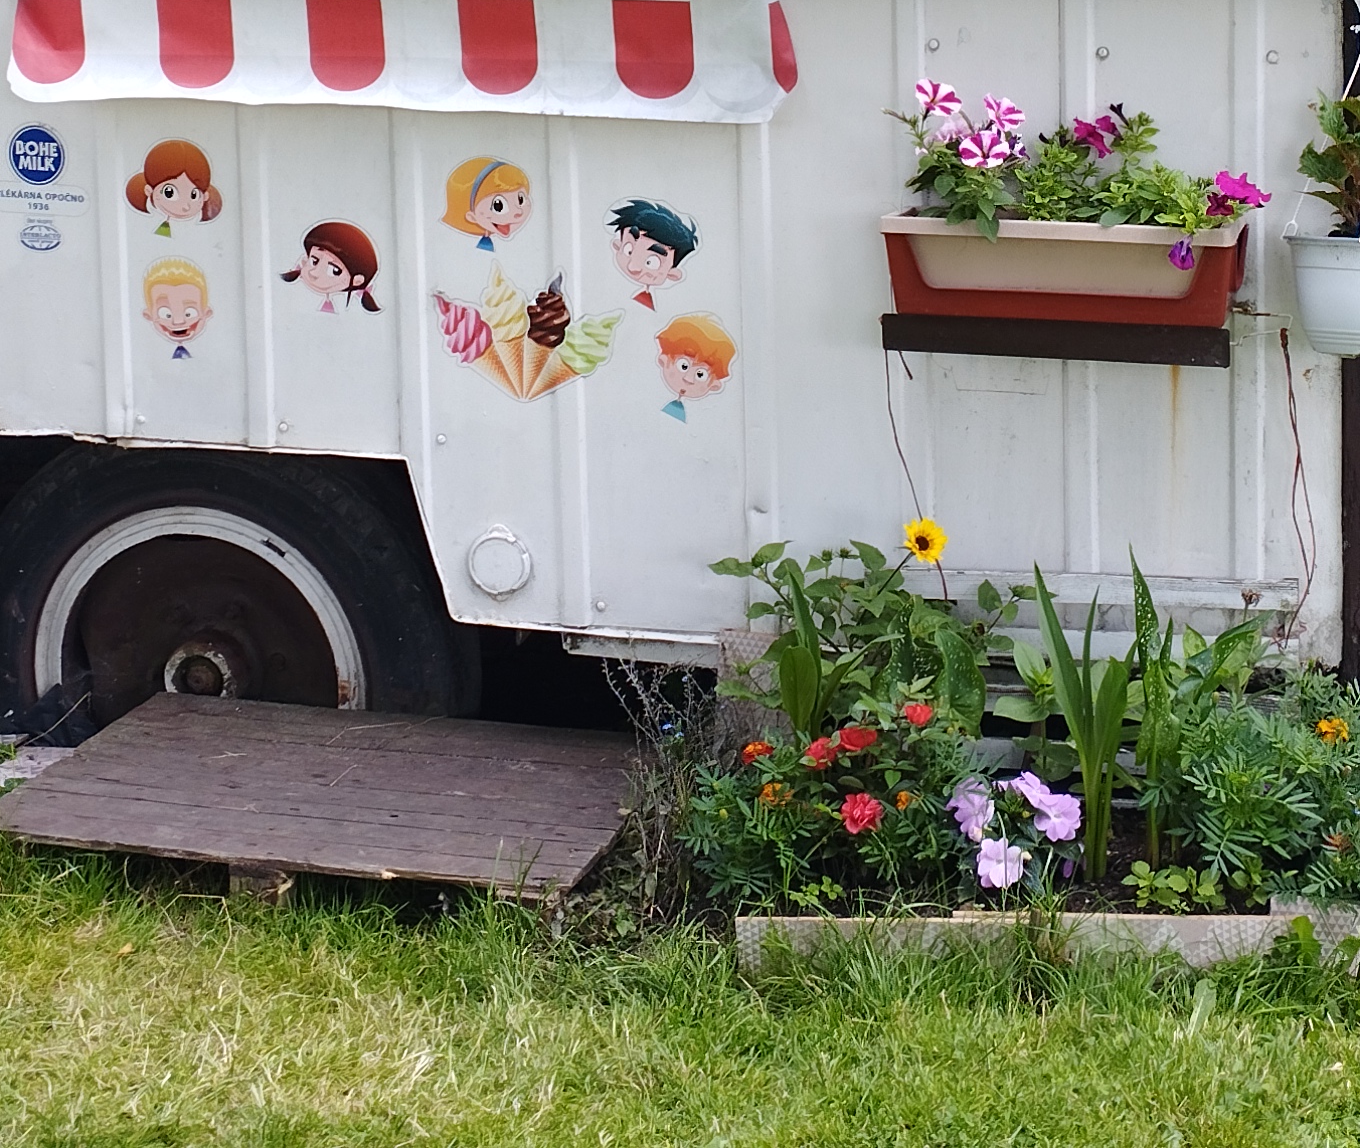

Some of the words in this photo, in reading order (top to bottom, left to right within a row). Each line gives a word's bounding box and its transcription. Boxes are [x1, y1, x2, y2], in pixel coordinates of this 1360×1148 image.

[15, 140, 58, 157] BOHE
[18, 156, 56, 172] MILK
[45, 193, 85, 203] OPOČNO
[28, 203, 49, 211] 1936
